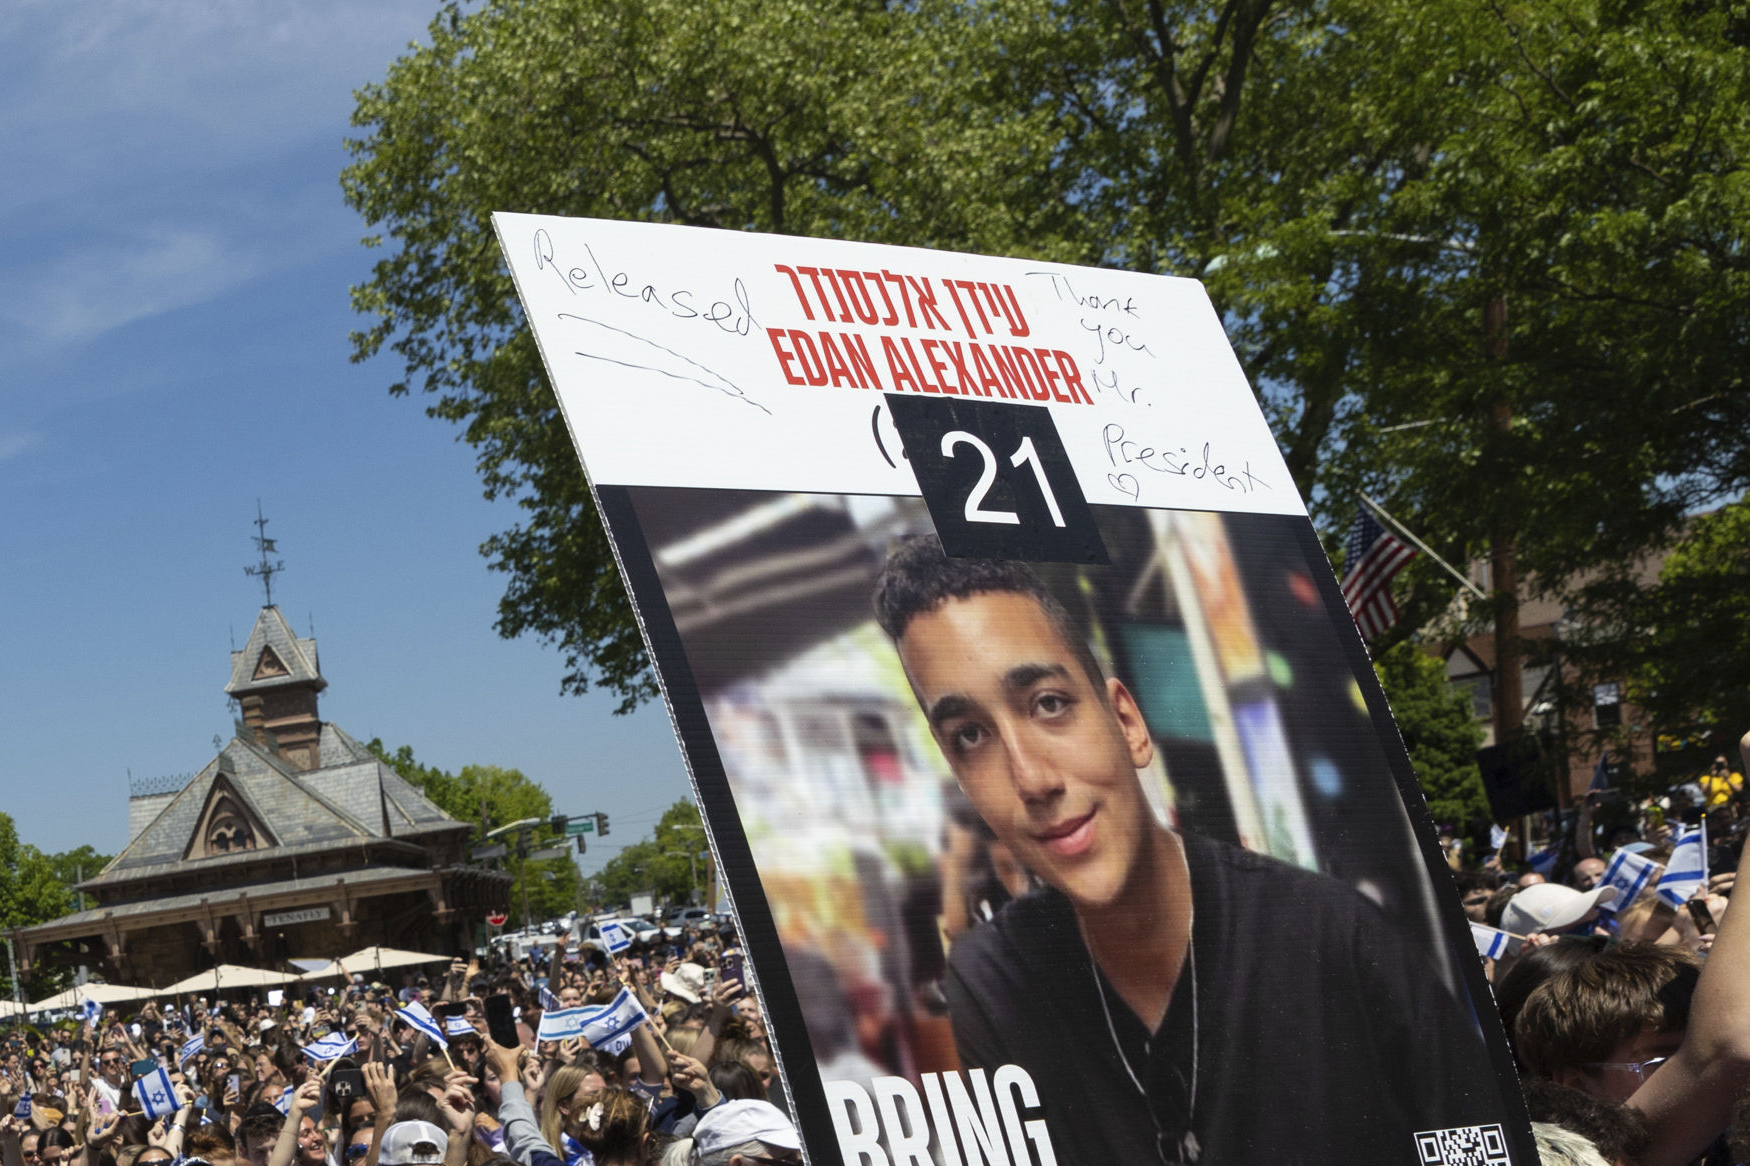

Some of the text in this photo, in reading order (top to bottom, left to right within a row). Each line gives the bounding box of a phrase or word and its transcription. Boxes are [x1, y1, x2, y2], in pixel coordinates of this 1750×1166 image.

[534, 229, 762, 336] Released
[773, 263, 1030, 340] עידן אלכסנדר
[1025, 272, 1141, 319] Thank
[766, 327, 1096, 405] EDAN ALEXANDER
[1081, 318, 1157, 364] you
[940, 430, 1067, 528] 21
[1103, 423, 1273, 494] President
